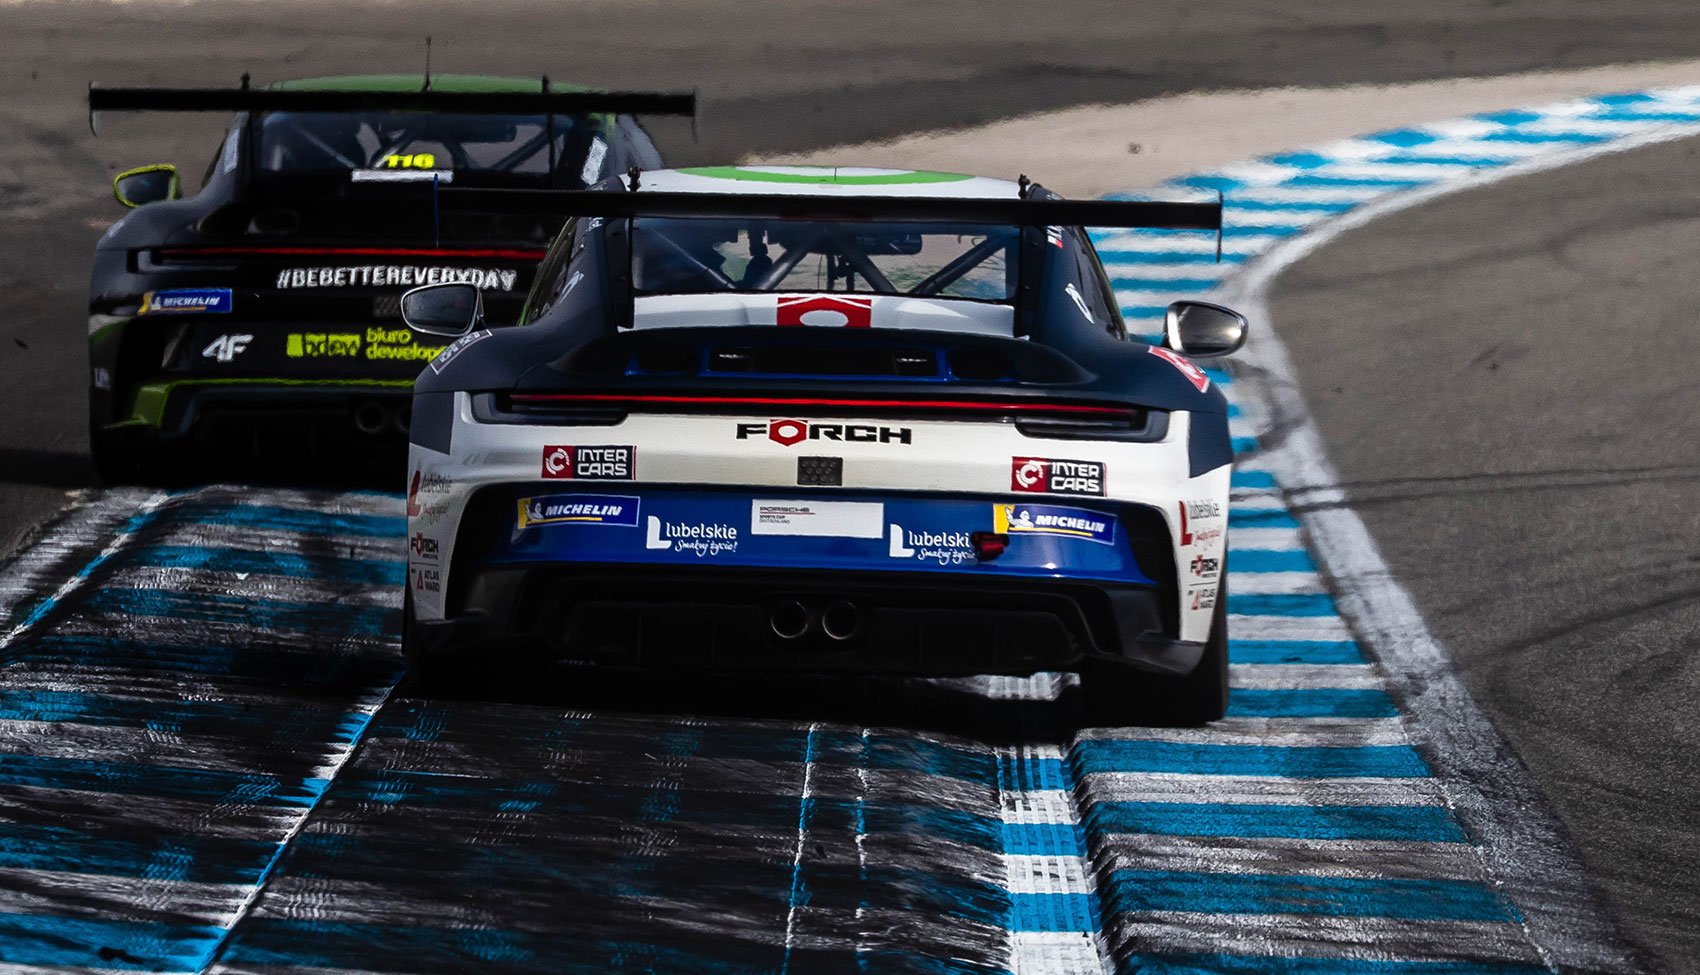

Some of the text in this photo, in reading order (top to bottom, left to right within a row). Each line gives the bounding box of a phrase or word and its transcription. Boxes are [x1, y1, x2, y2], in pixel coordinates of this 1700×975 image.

[163, 297, 221, 307] MICHELIN
[366, 327, 412, 344] biuro
[577, 449, 628, 462] INTER
[577, 463, 628, 476] CARS
[1051, 462, 1100, 478] INTER
[1051, 476, 1100, 492] CARS
[545, 504, 623, 517] MICHELIN
[1035, 515, 1106, 533] MICHELIN
[908, 530, 974, 548] lubelski
